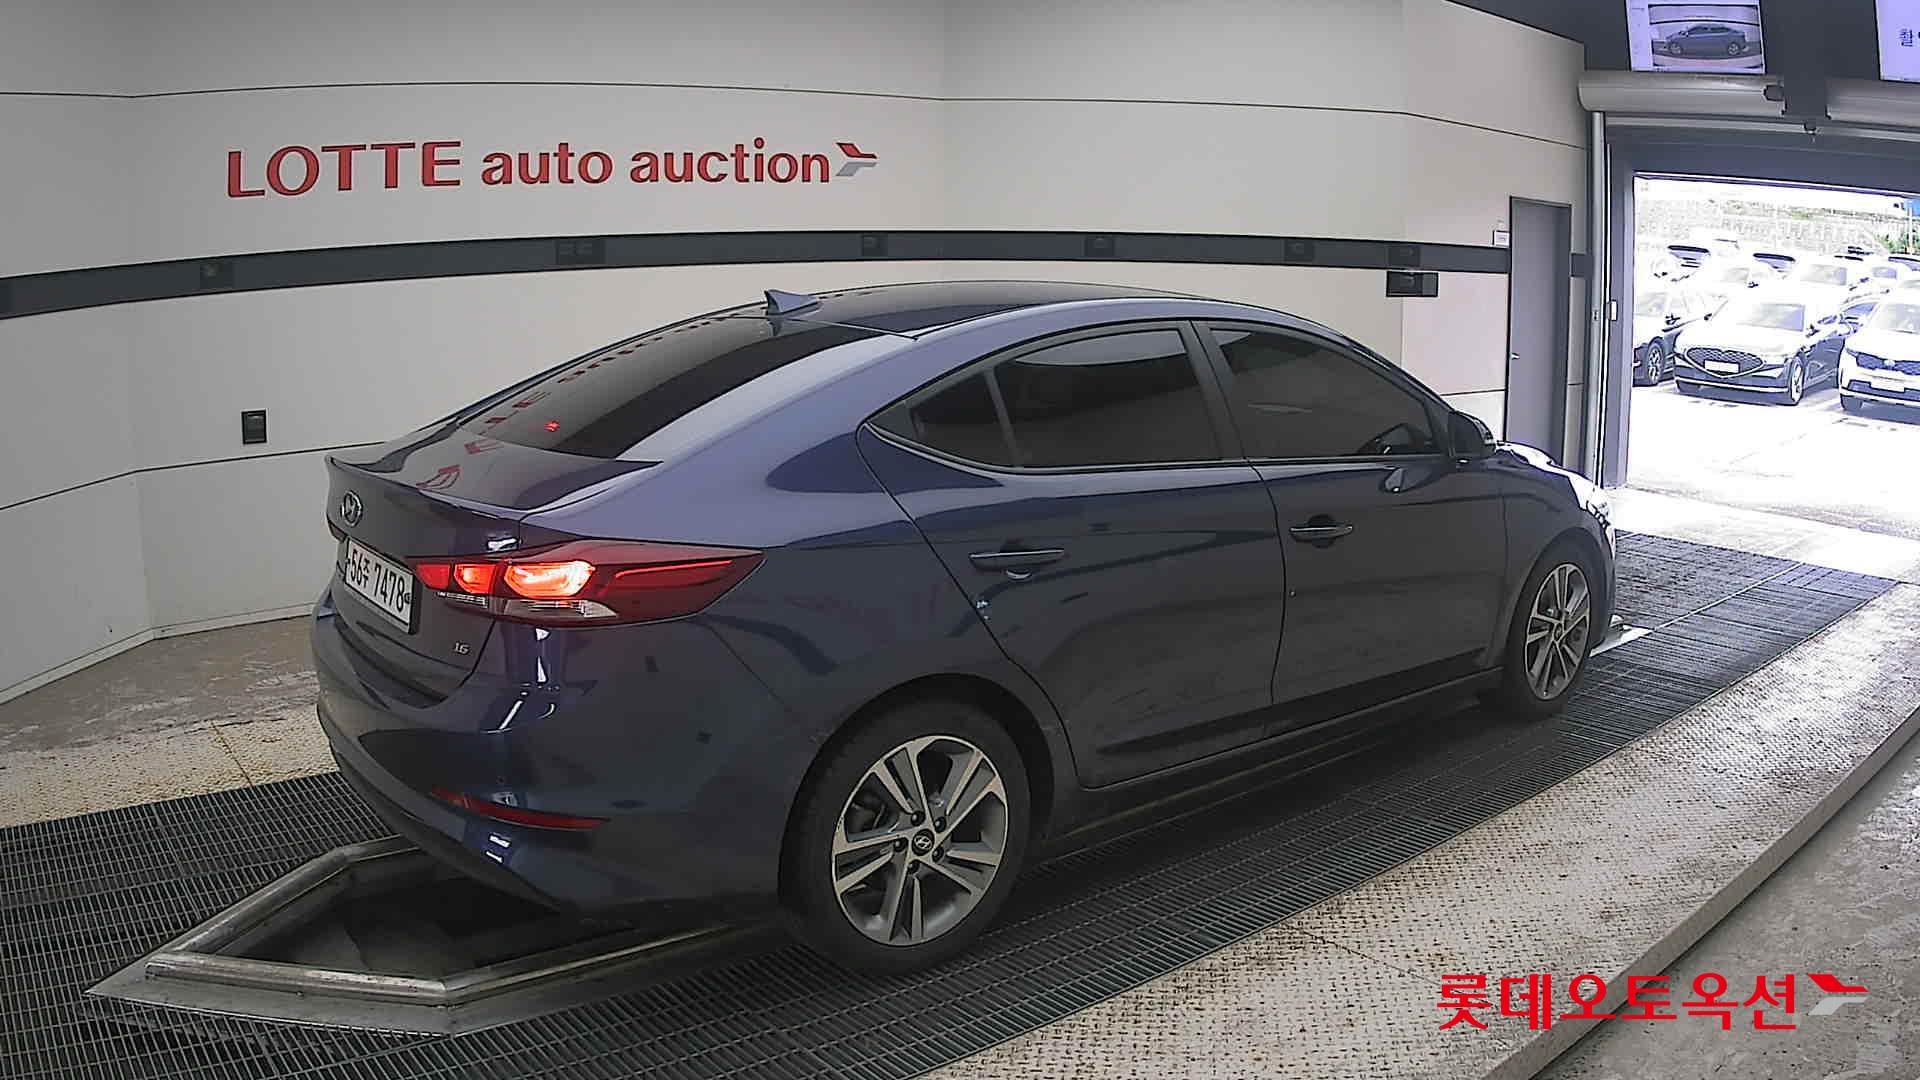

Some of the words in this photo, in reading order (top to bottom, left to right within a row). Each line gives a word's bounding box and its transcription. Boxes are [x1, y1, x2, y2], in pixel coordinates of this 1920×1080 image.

[227, 141, 461, 198] LOTTE
[481, 142, 613, 185] auto
[630, 137, 830, 183] auction
[374, 562, 405, 613] 7478
